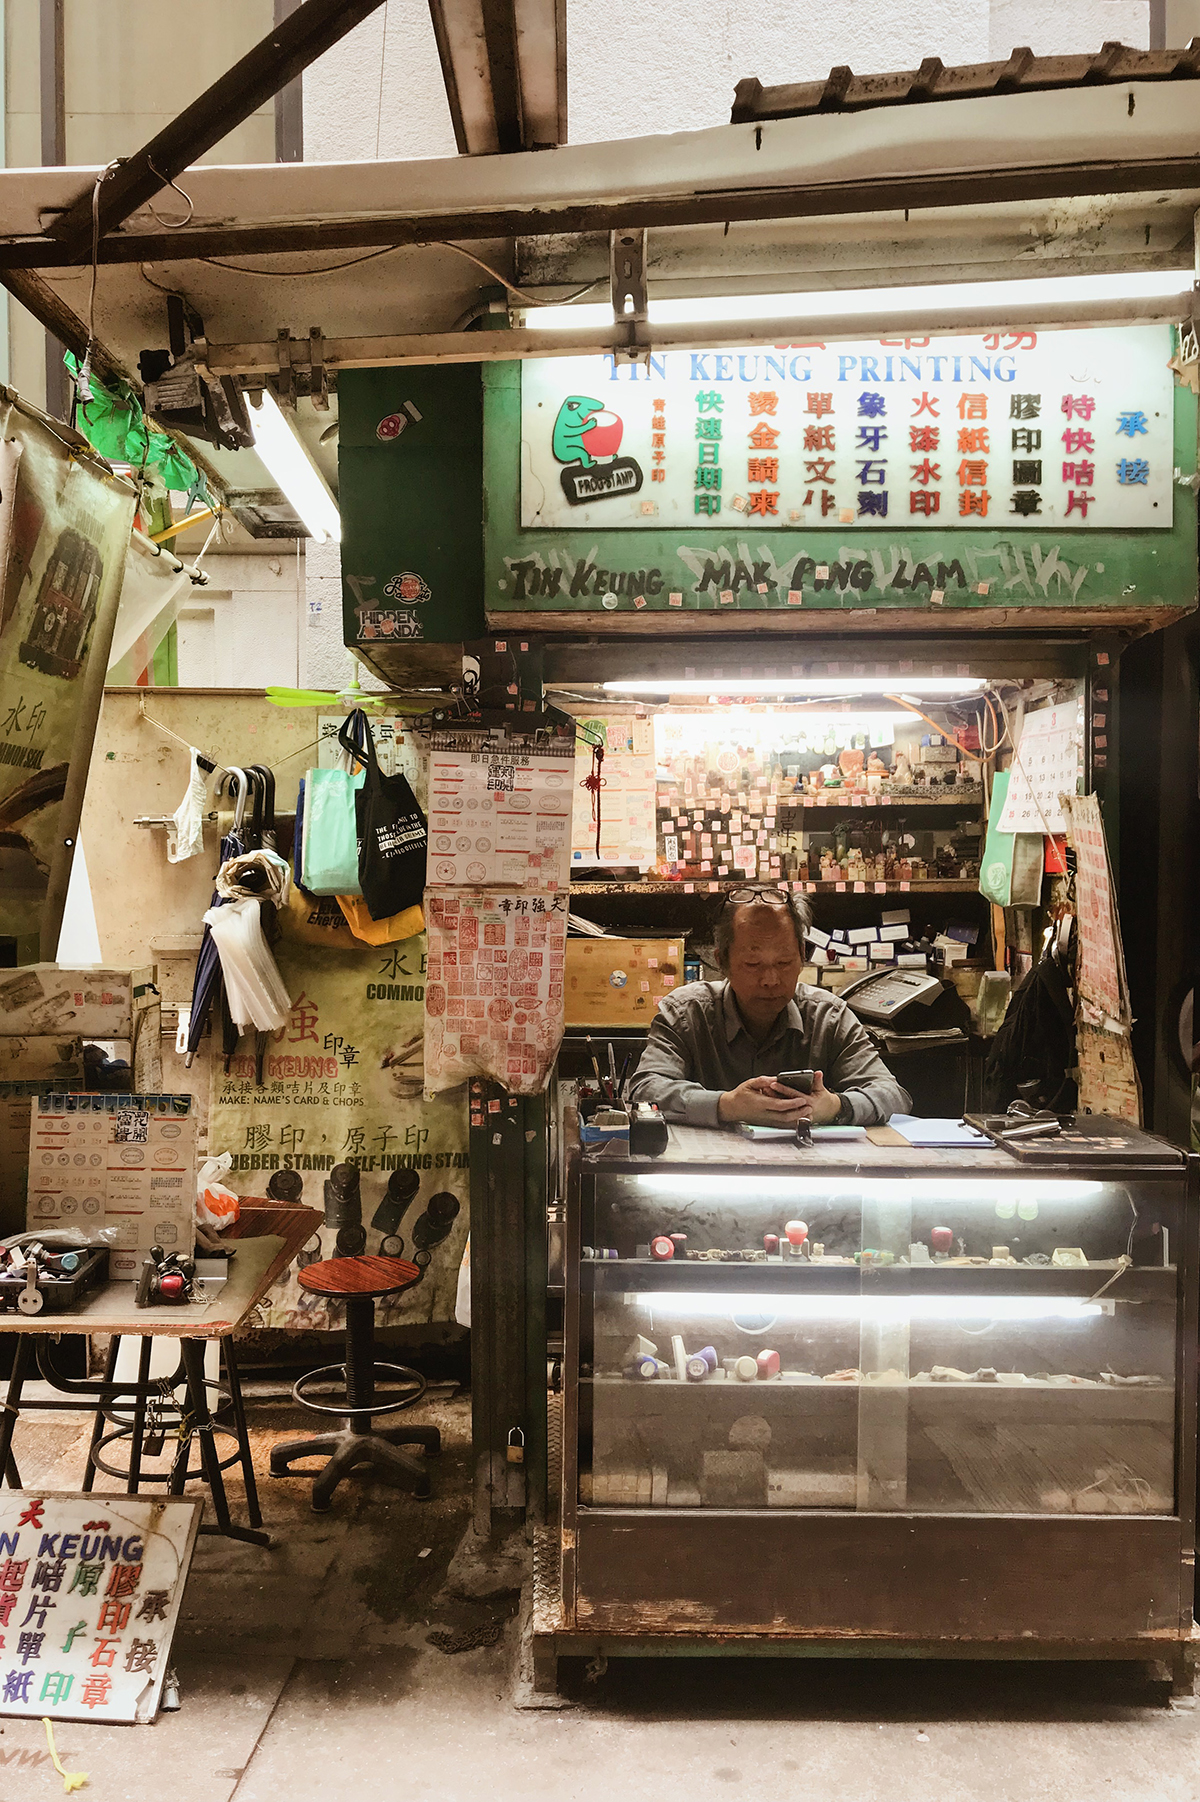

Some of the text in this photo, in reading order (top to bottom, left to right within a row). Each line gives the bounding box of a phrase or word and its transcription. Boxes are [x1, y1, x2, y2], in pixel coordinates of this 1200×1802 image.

[603, 354, 1018, 382] TIN KEUNG PRINTING
[651, 397, 666, 484] 青蛙原子印
[694, 389, 725, 517] 快速日期印
[856, 391, 888, 517] 象牙石刻
[909, 391, 940, 516] 火漆水印
[957, 392, 990, 517] 信紙信封
[1009, 393, 1042, 516] 膠印圖章
[1061, 394, 1095, 518] 特快咭片
[1115, 411, 1149, 485] 承接
[510, 561, 562, 600] TIN
[569, 558, 665, 598] KEUNG
[695, 557, 777, 592] MAK
[791, 557, 874, 592] PING
[892, 558, 967, 590] LAM
[361, 611, 419, 625] HIDDEN
[1, 696, 47, 744] 水印
[1051, 712, 1056, 726] 3
[470, 754, 530, 766] 即日急件服務
[1025, 792, 1032, 800] 19
[268, 1054, 338, 1080] KEUNG
[323, 1032, 361, 1069] 印章
[219, 1095, 250, 1105] MAKE:
[294, 1096, 319, 1105] CARD
[322, 1097, 330, 1106] &
[332, 1097, 364, 1107] CHOPS
[283, 1153, 335, 1171] STAMP
[17, 1499, 45, 1529] 天
[37, 1533, 144, 1562] KEUNG
[2, 1560, 67, 1704] 咭片單紙
[80, 1562, 144, 1709] 膠印石章
[123, 1590, 172, 1674] 承接
